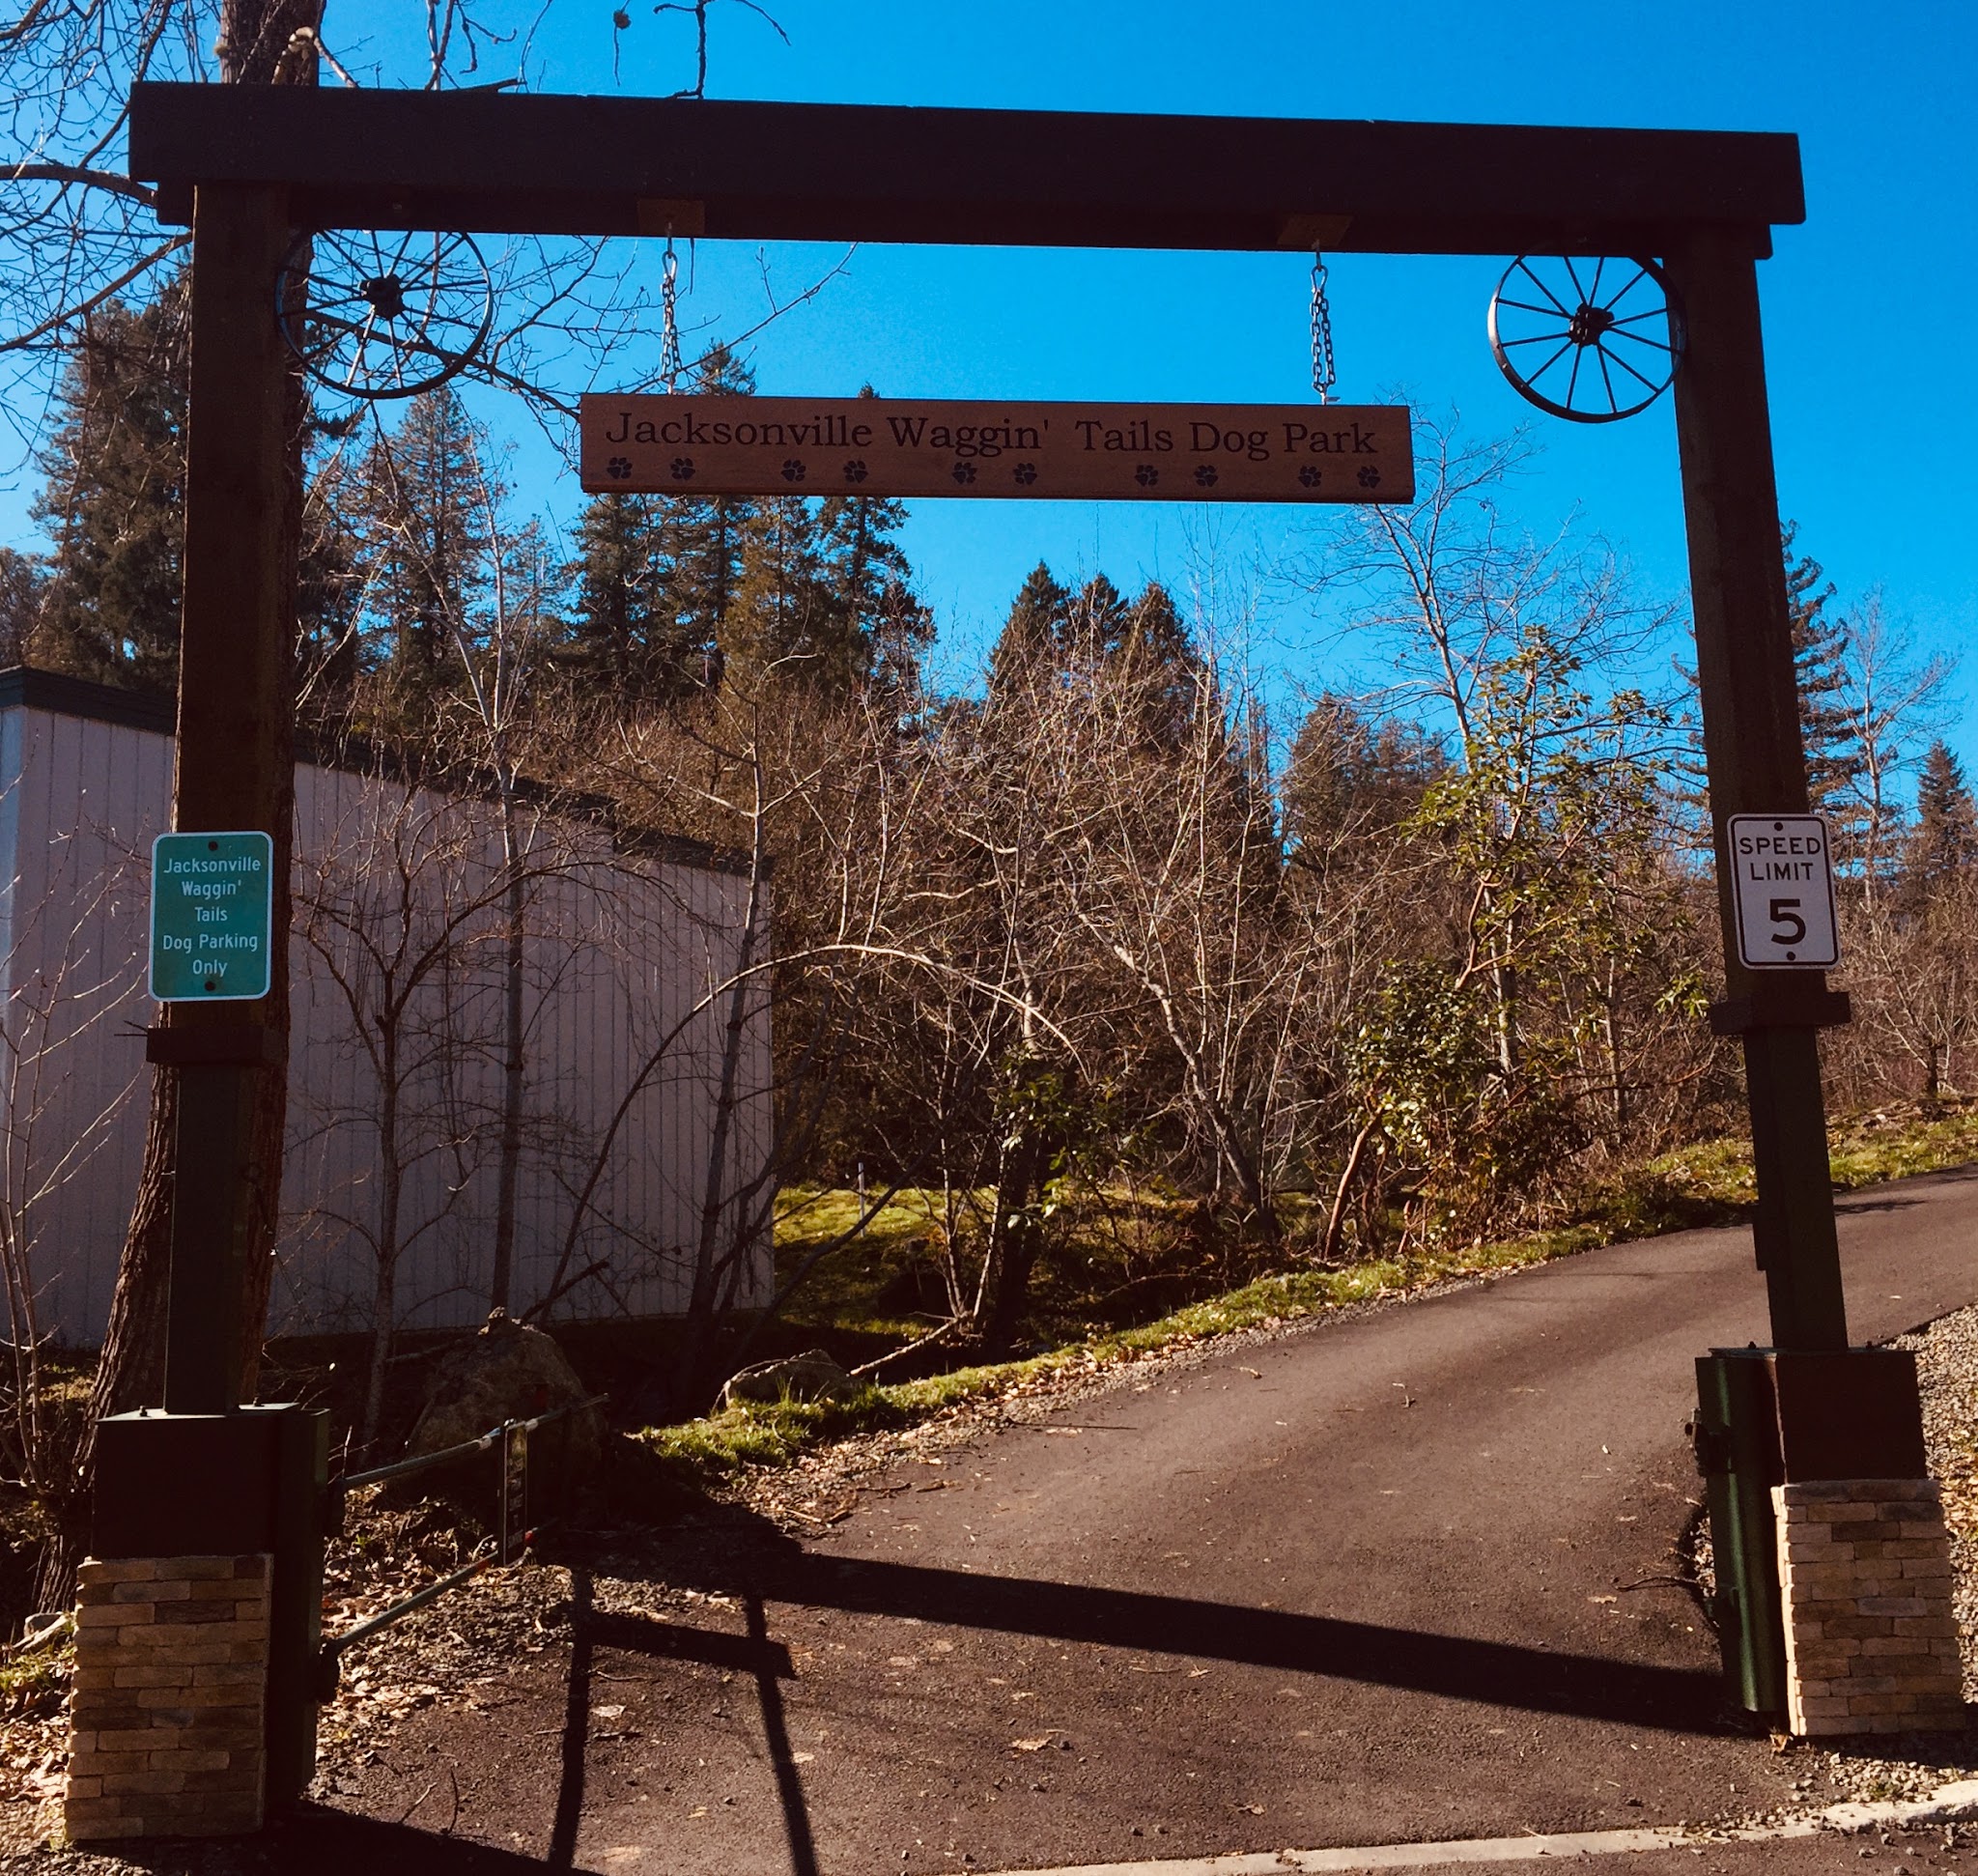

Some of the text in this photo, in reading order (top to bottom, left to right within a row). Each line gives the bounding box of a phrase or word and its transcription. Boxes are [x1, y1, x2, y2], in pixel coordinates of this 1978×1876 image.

[606, 412, 1378, 462] Jacksonville Waggin' Tails Dog Park
[1739, 837, 1822, 856] SPEED
[163, 856, 262, 873] Jacksonville
[1750, 862, 1814, 881] LIMIT
[182, 879, 241, 900] Waggin'
[195, 906, 228, 922] Tails
[1769, 898, 1806, 945] 5
[163, 933, 258, 954] Dog Parking
[193, 959, 228, 978] Only
